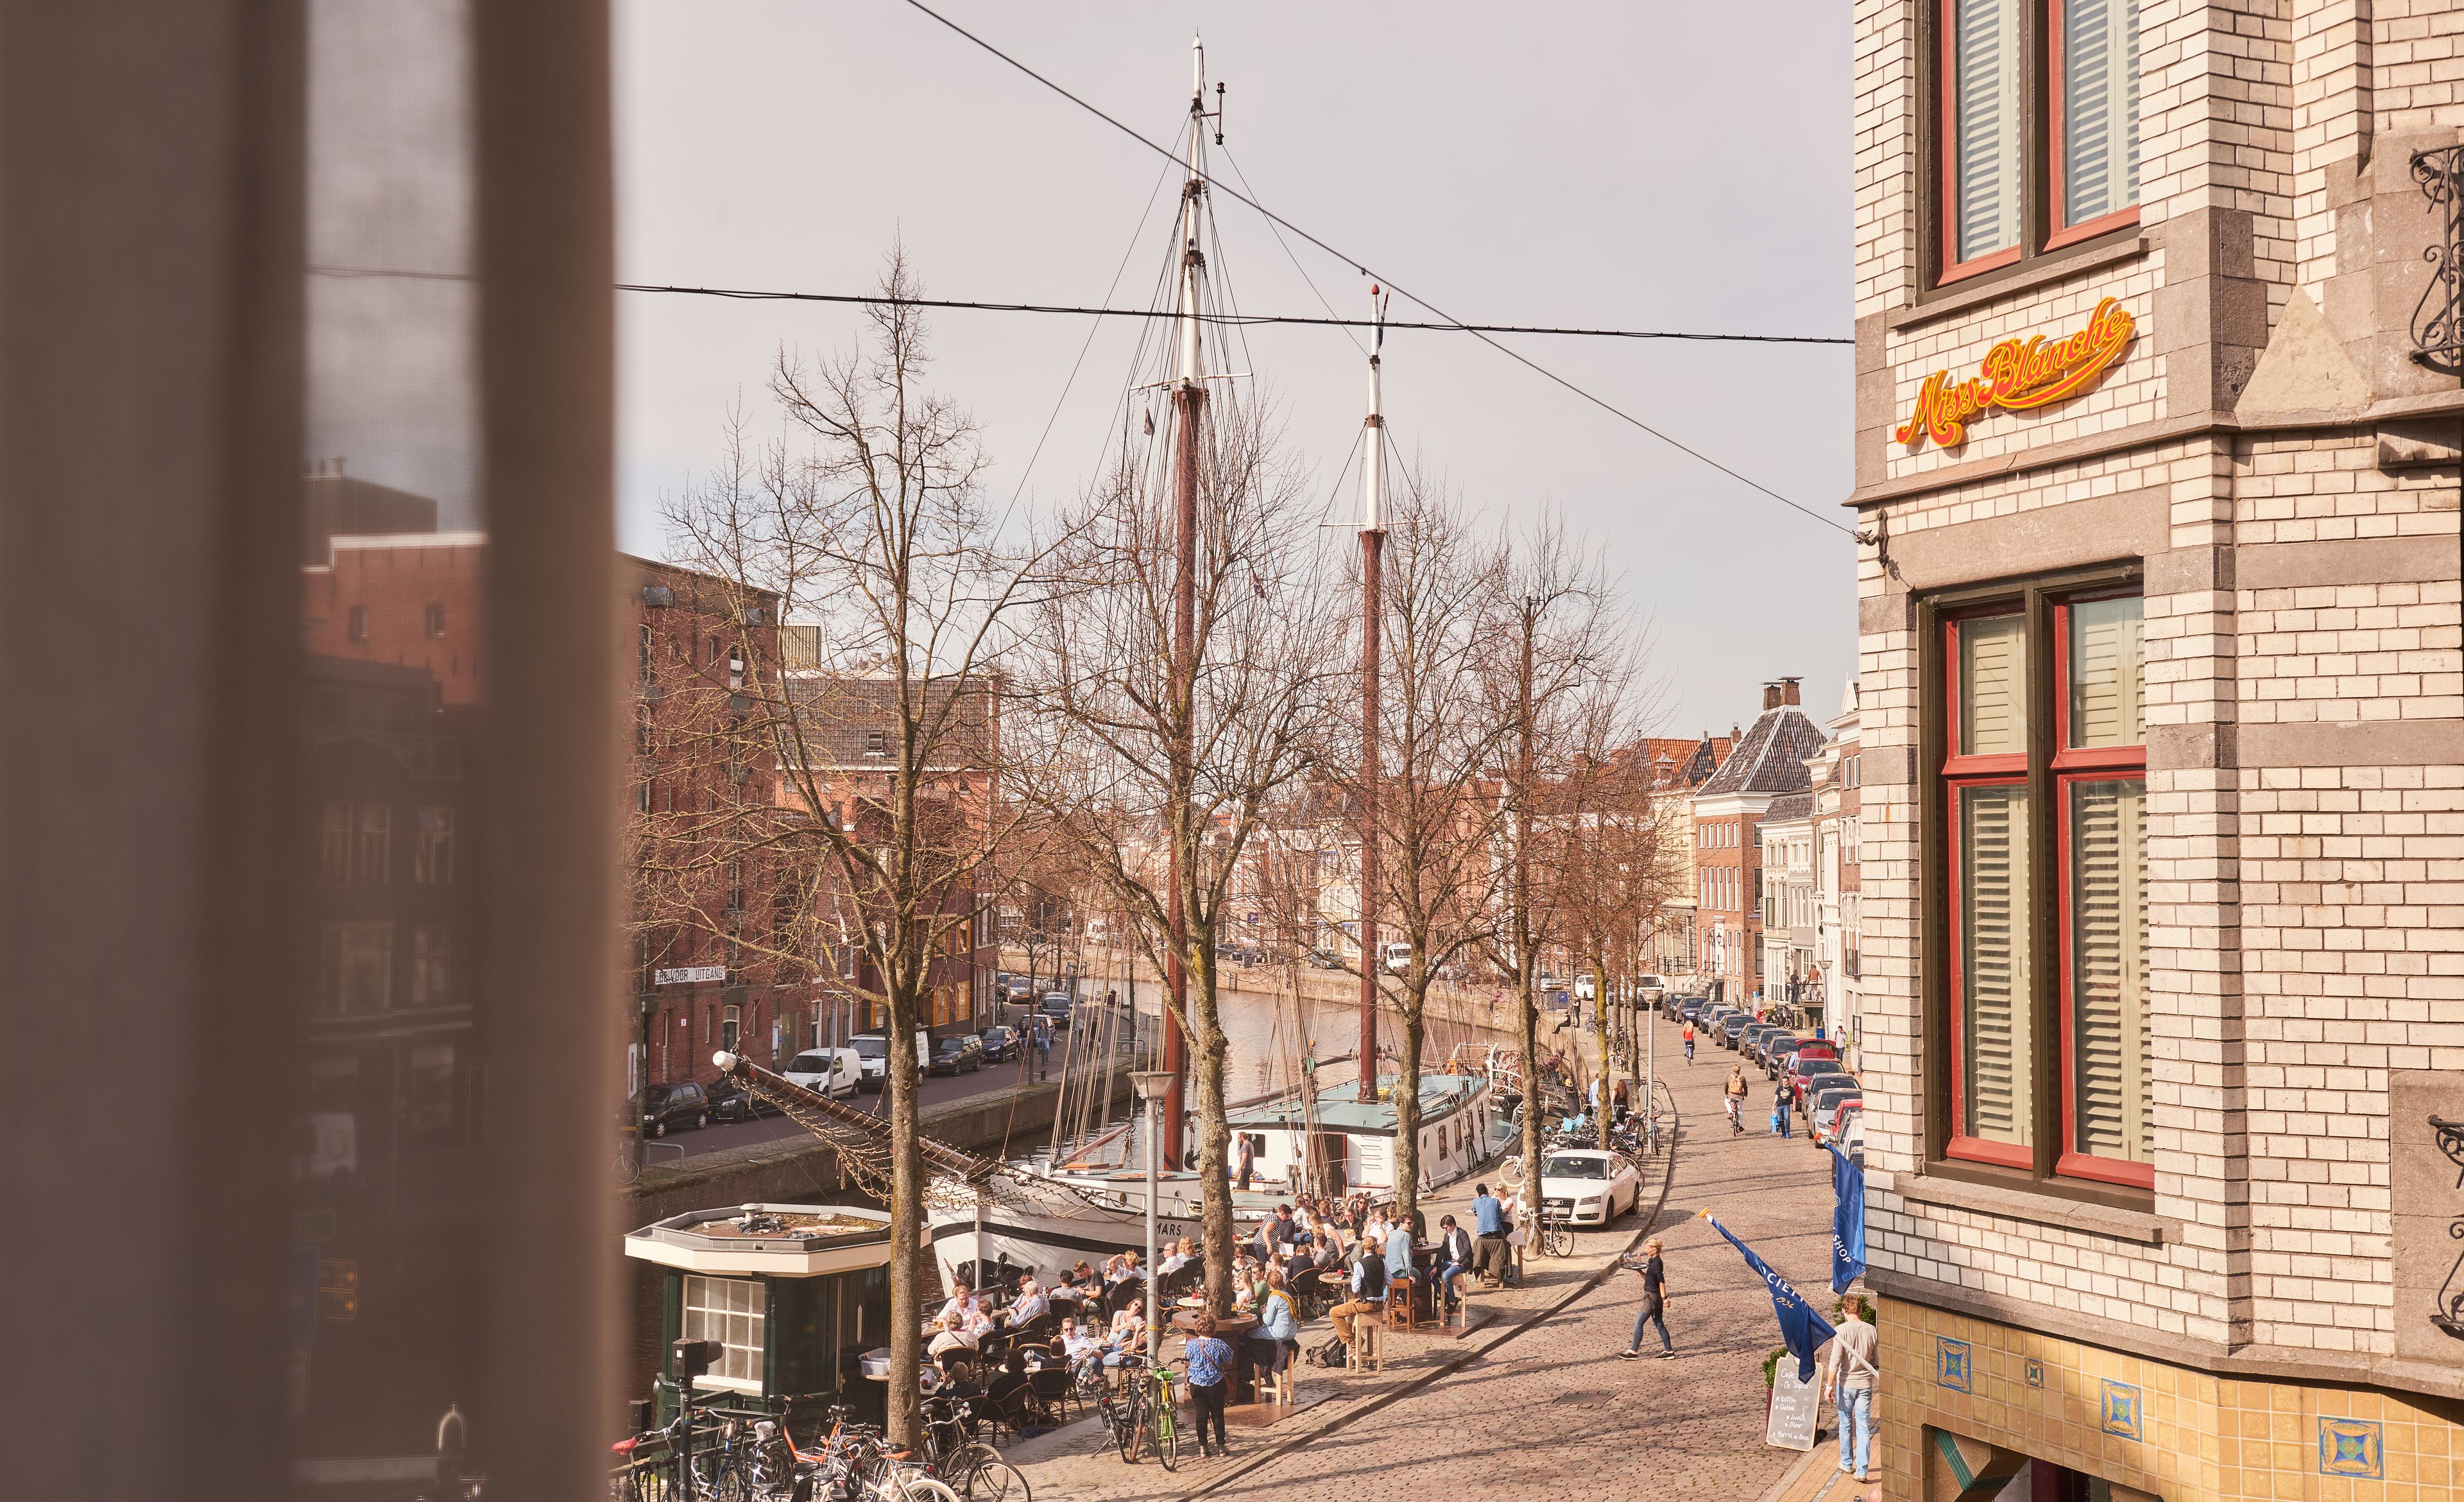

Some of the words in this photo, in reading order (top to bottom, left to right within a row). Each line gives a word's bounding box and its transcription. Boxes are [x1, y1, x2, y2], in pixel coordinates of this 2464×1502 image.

[1895, 369, 1980, 447] Miss
[1976, 296, 2134, 408] Blanche
[1833, 1234, 1851, 1263] SHOP
[1775, 1297, 1795, 1309] 1934
[1790, 1413, 1806, 1422] Lunch
[1777, 1430, 1793, 1439] Borrel
